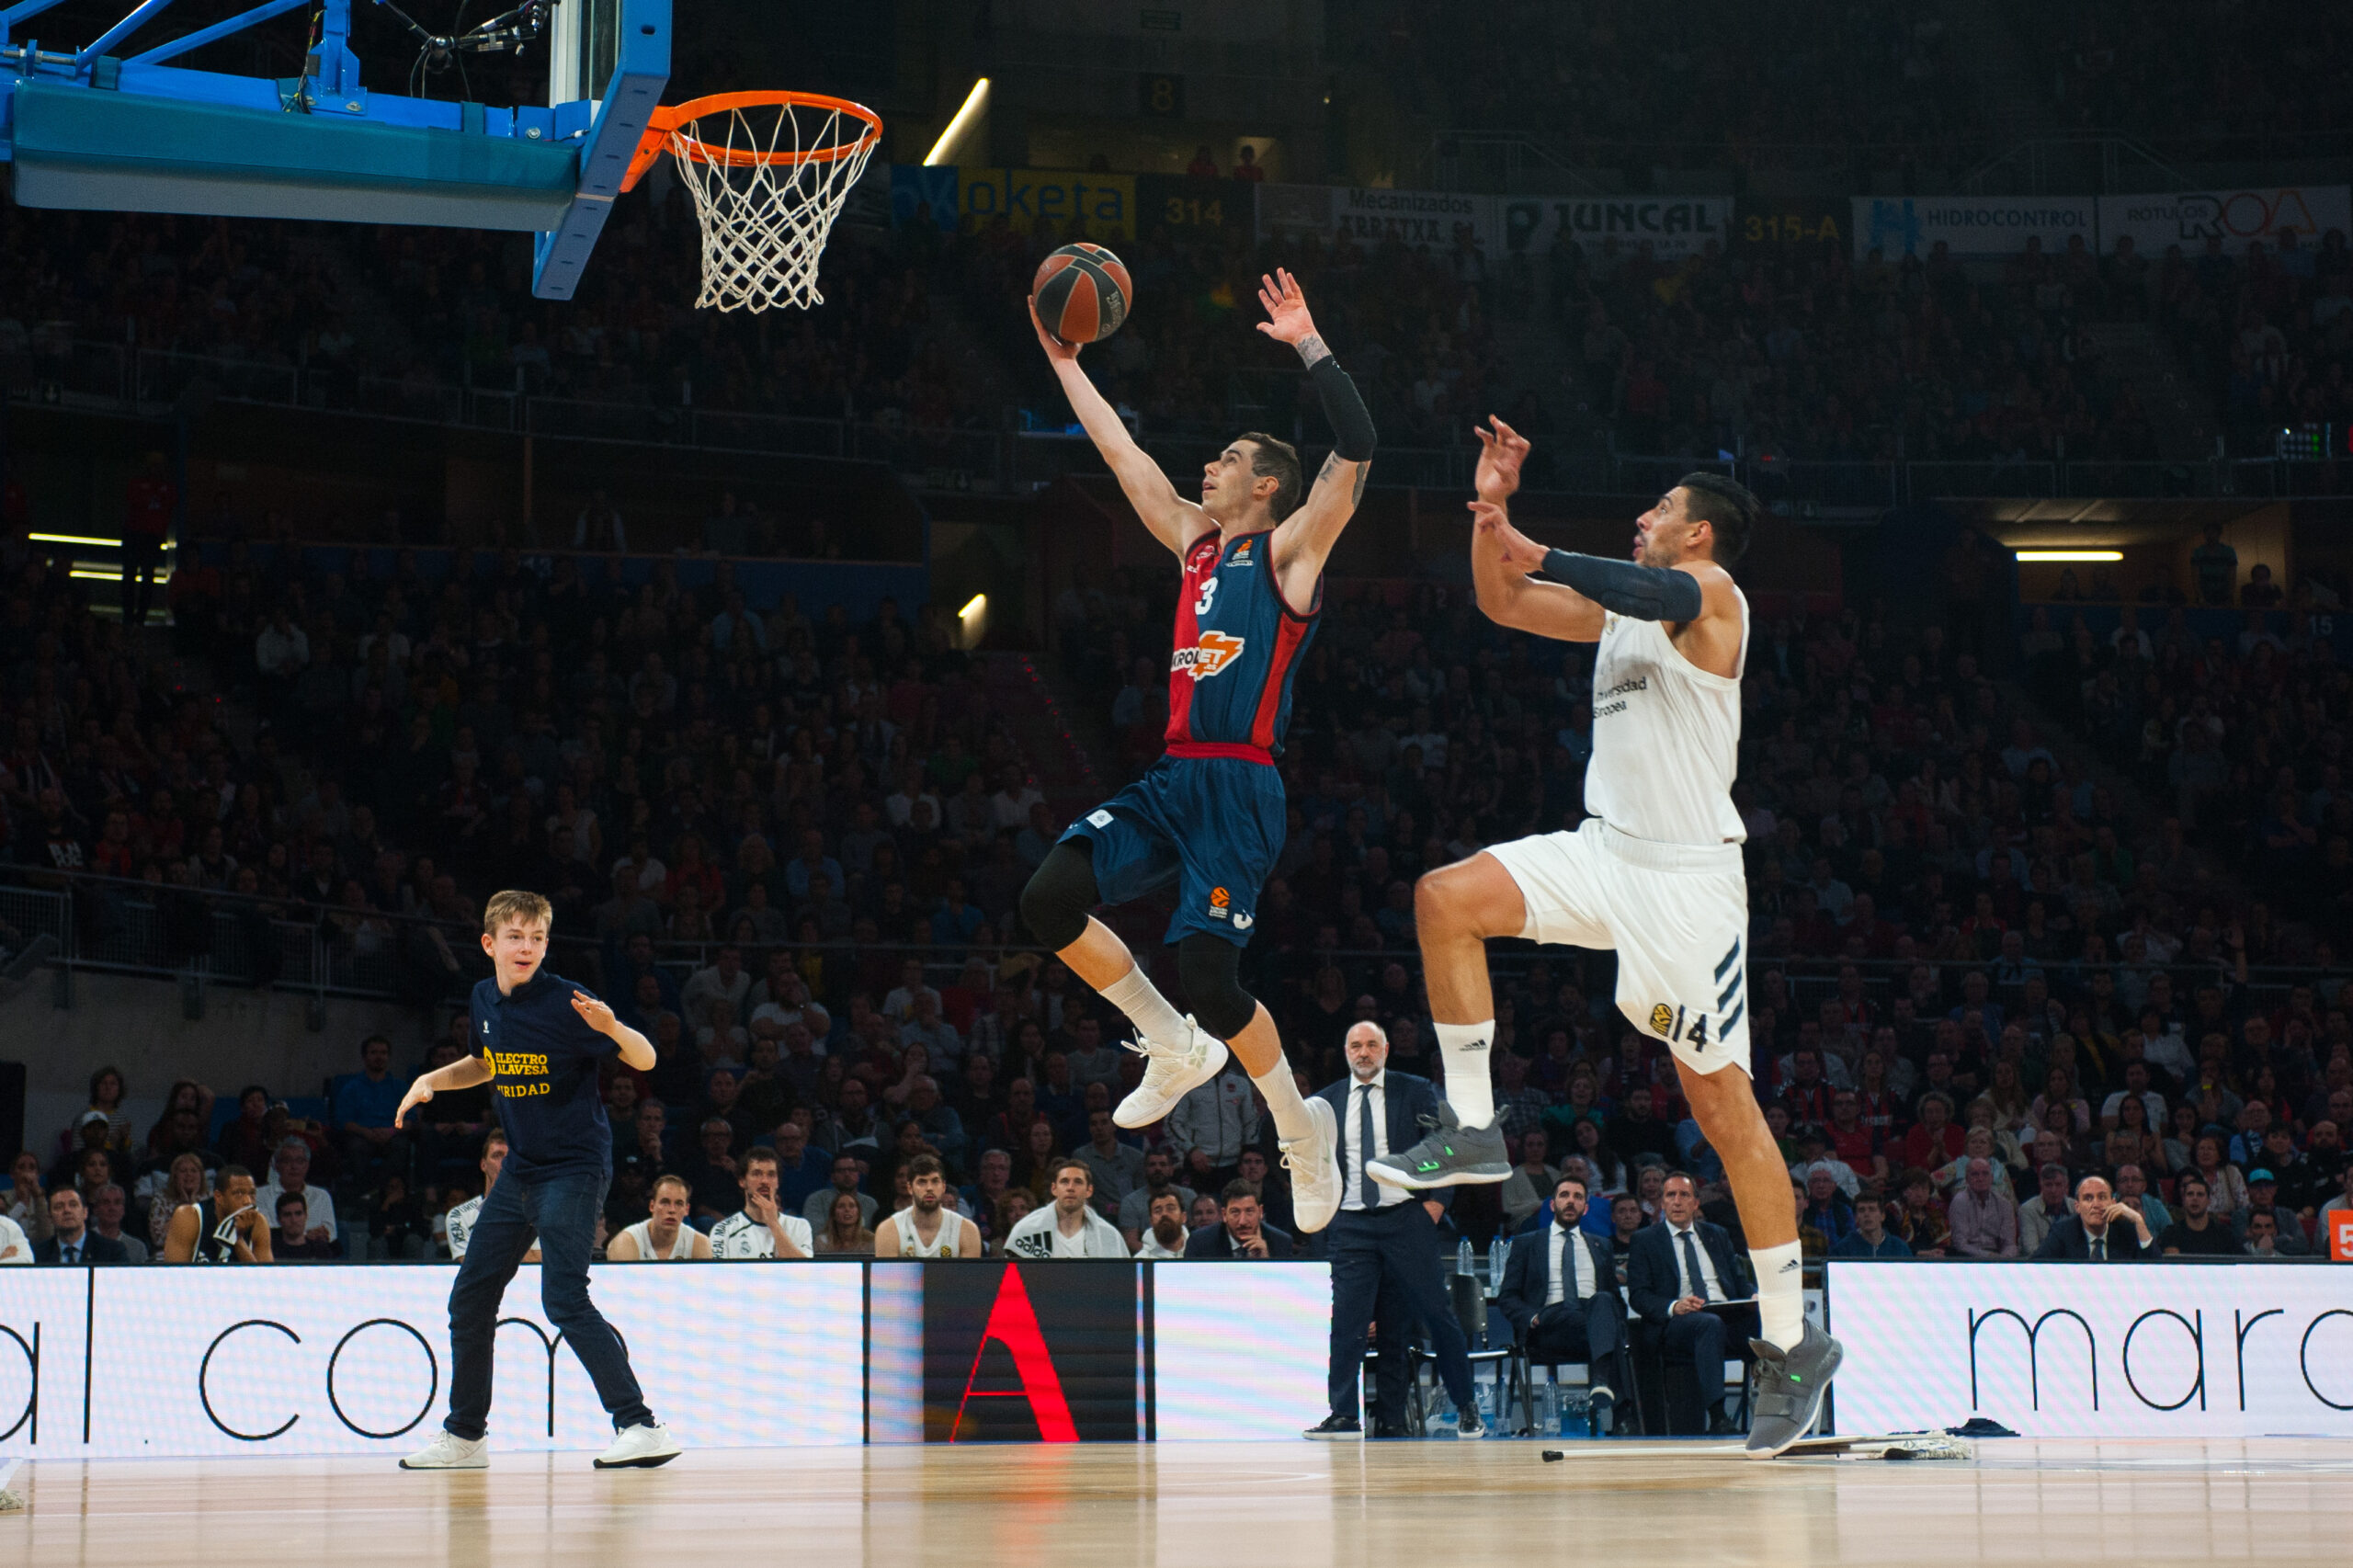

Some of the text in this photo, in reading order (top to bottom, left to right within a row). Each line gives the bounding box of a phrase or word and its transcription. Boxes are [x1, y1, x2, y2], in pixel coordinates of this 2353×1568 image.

[1152, 77, 1174, 111] 8
[967, 169, 1124, 221] oketa
[1348, 189, 1473, 213] Mecanizados
[1165, 197, 1224, 226] 314
[1554, 203, 1717, 234] JUNCAL
[1929, 209, 2086, 228] HIDROCONTROL
[2177, 187, 2316, 240] ROA
[1745, 214, 1838, 243] 315-A
[1195, 577, 1219, 616] 3
[1672, 1004, 1708, 1052] 14
[494, 1052, 548, 1065] ELECTRO
[497, 1064, 550, 1075] ALAVESA
[949, 1262, 1080, 1442] A
